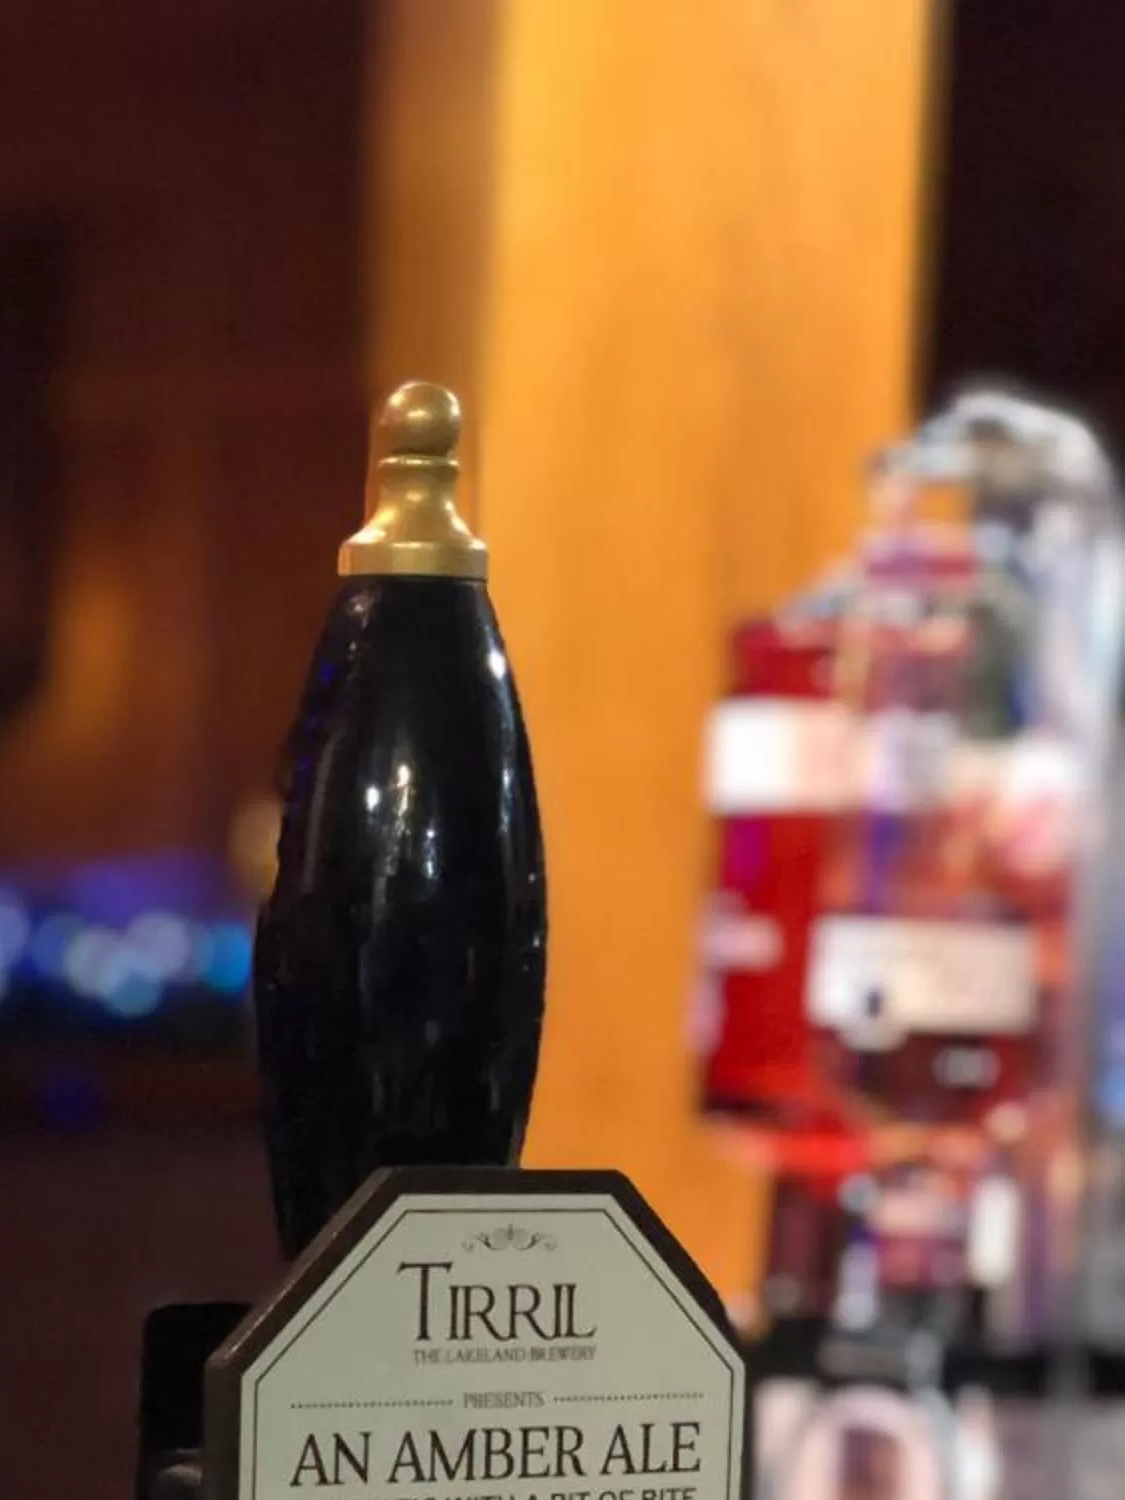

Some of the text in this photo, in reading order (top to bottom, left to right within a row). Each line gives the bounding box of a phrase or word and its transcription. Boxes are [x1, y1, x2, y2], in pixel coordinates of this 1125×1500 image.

[413, 1345, 597, 1365] THE LAKELAND BREWERY
[463, 1391, 545, 1409] PRESENTS
[289, 1421, 702, 1487] AN AMBER ALE
